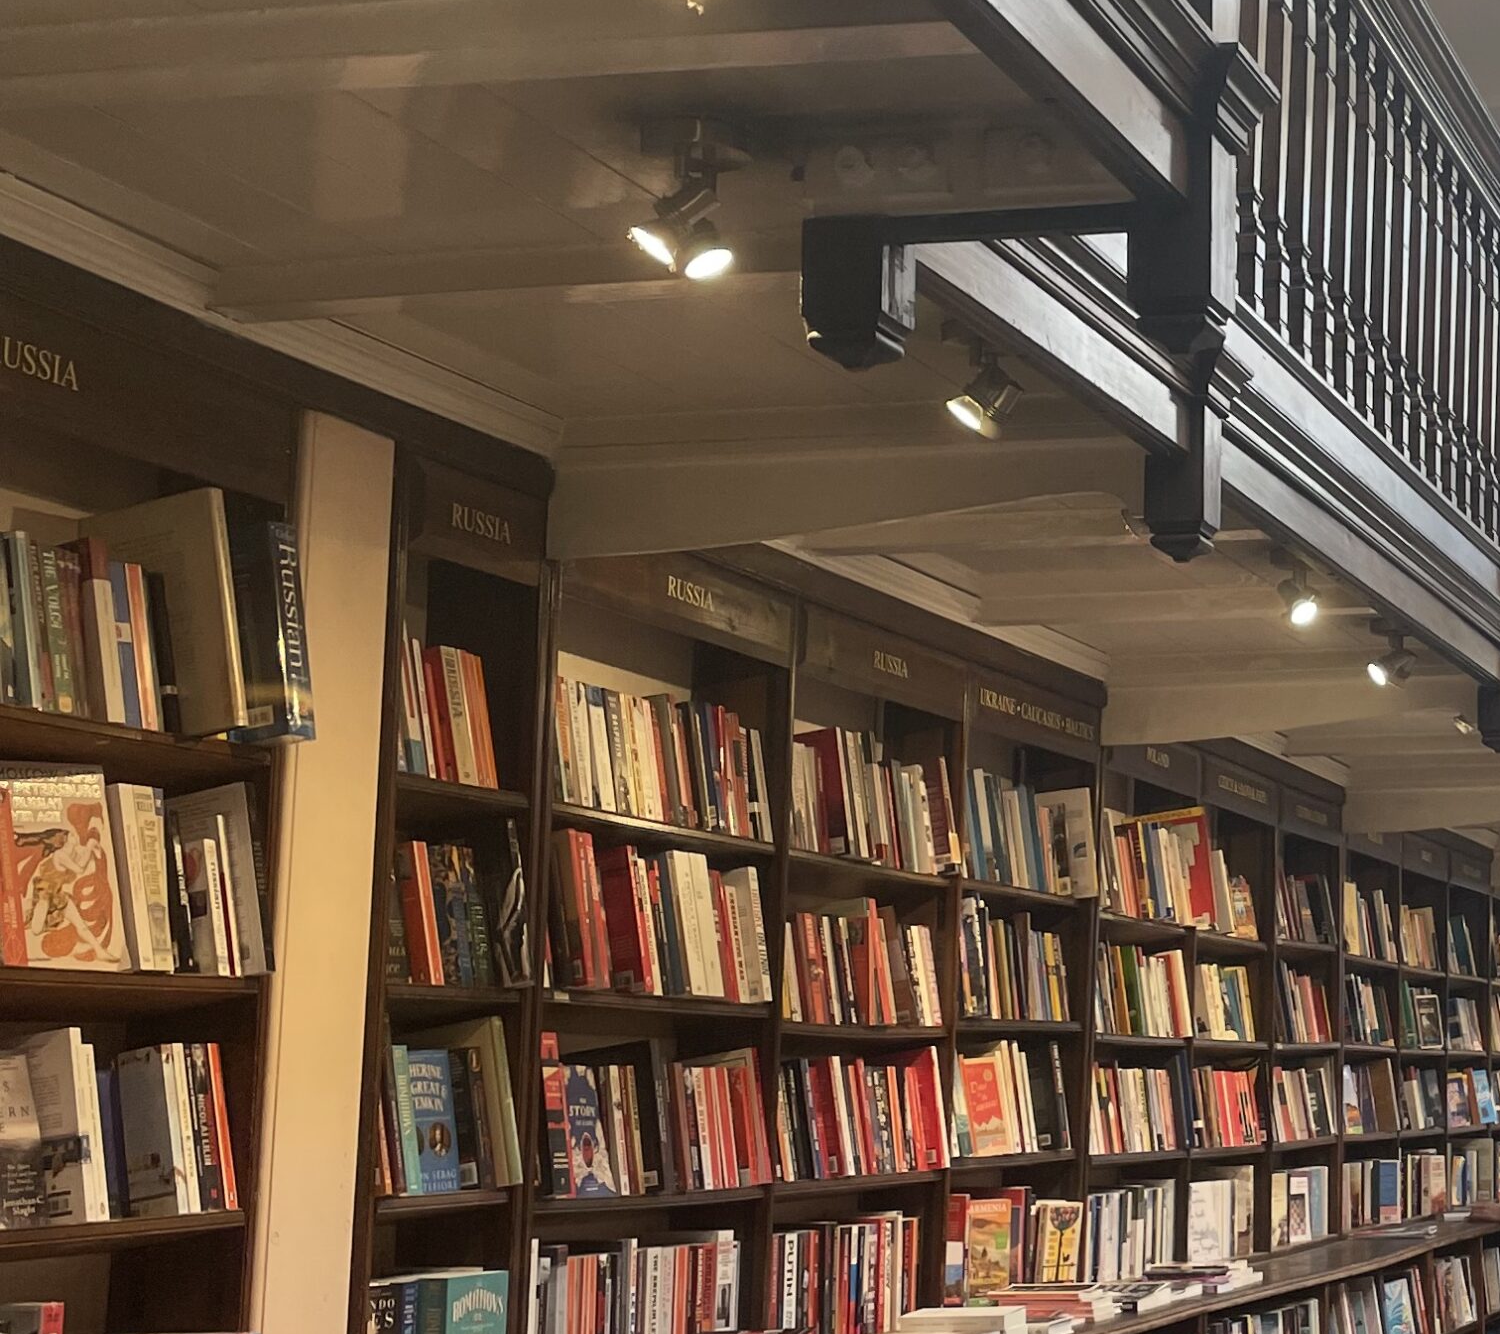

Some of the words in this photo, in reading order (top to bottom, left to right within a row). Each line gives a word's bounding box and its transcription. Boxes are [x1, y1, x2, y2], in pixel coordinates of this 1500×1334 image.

[0, 335, 79, 392] USSIA
[452, 502, 511, 544] RUSSIA
[279, 543, 303, 668] Russian
[667, 575, 715, 612] RUSSIA
[874, 650, 909, 679] RUSSIA
[979, 687, 1017, 716] UKRAINE
[1020, 702, 1062, 730] CAUCASUS
[969, 1202, 1008, 1214] ARMENIA
[786, 1239, 795, 1297] PUTIN
